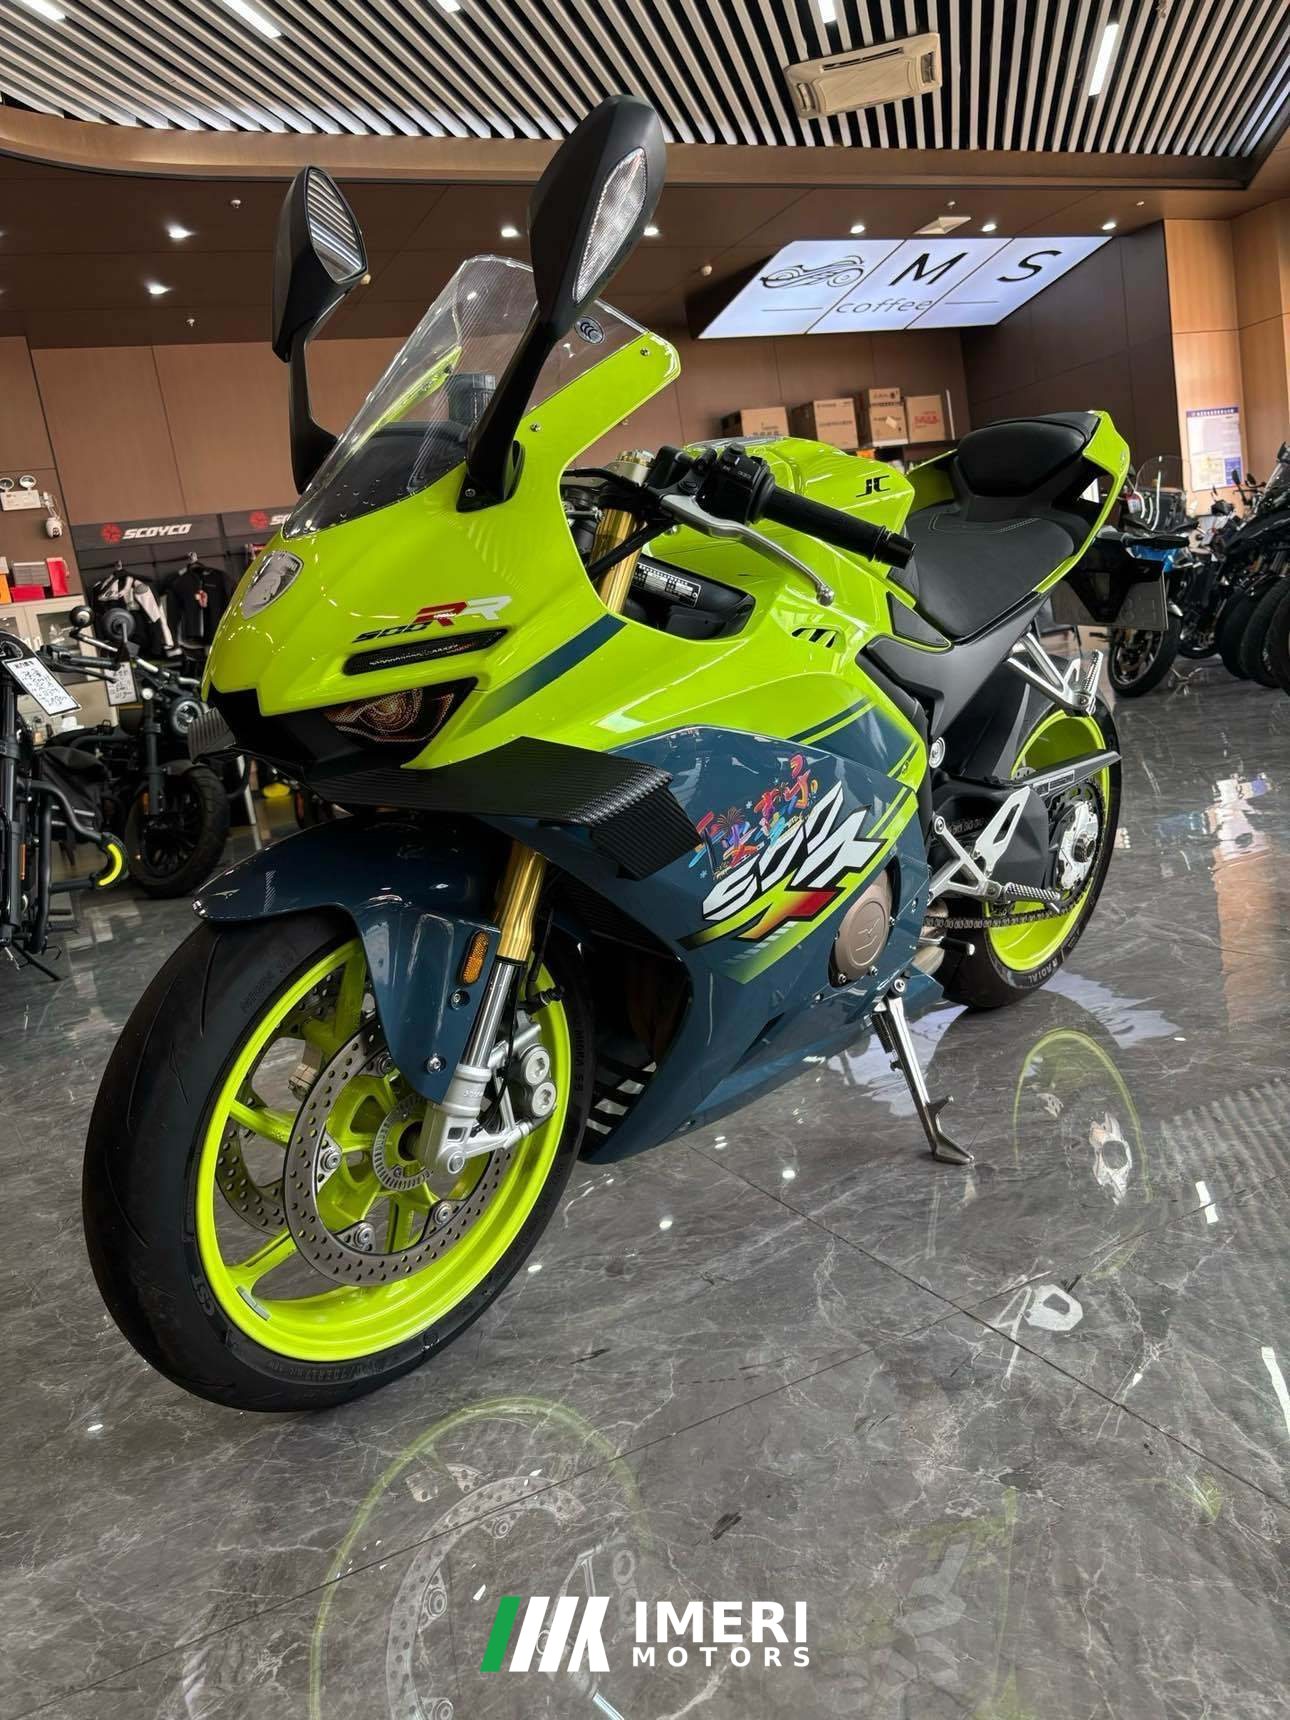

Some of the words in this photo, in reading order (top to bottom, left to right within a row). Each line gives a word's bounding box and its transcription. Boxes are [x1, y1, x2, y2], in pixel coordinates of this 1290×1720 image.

[889, 252, 968, 287] M
[997, 250, 1063, 283] S
[836, 298, 936, 314] coffee
[122, 523, 192, 540] SCOYCO
